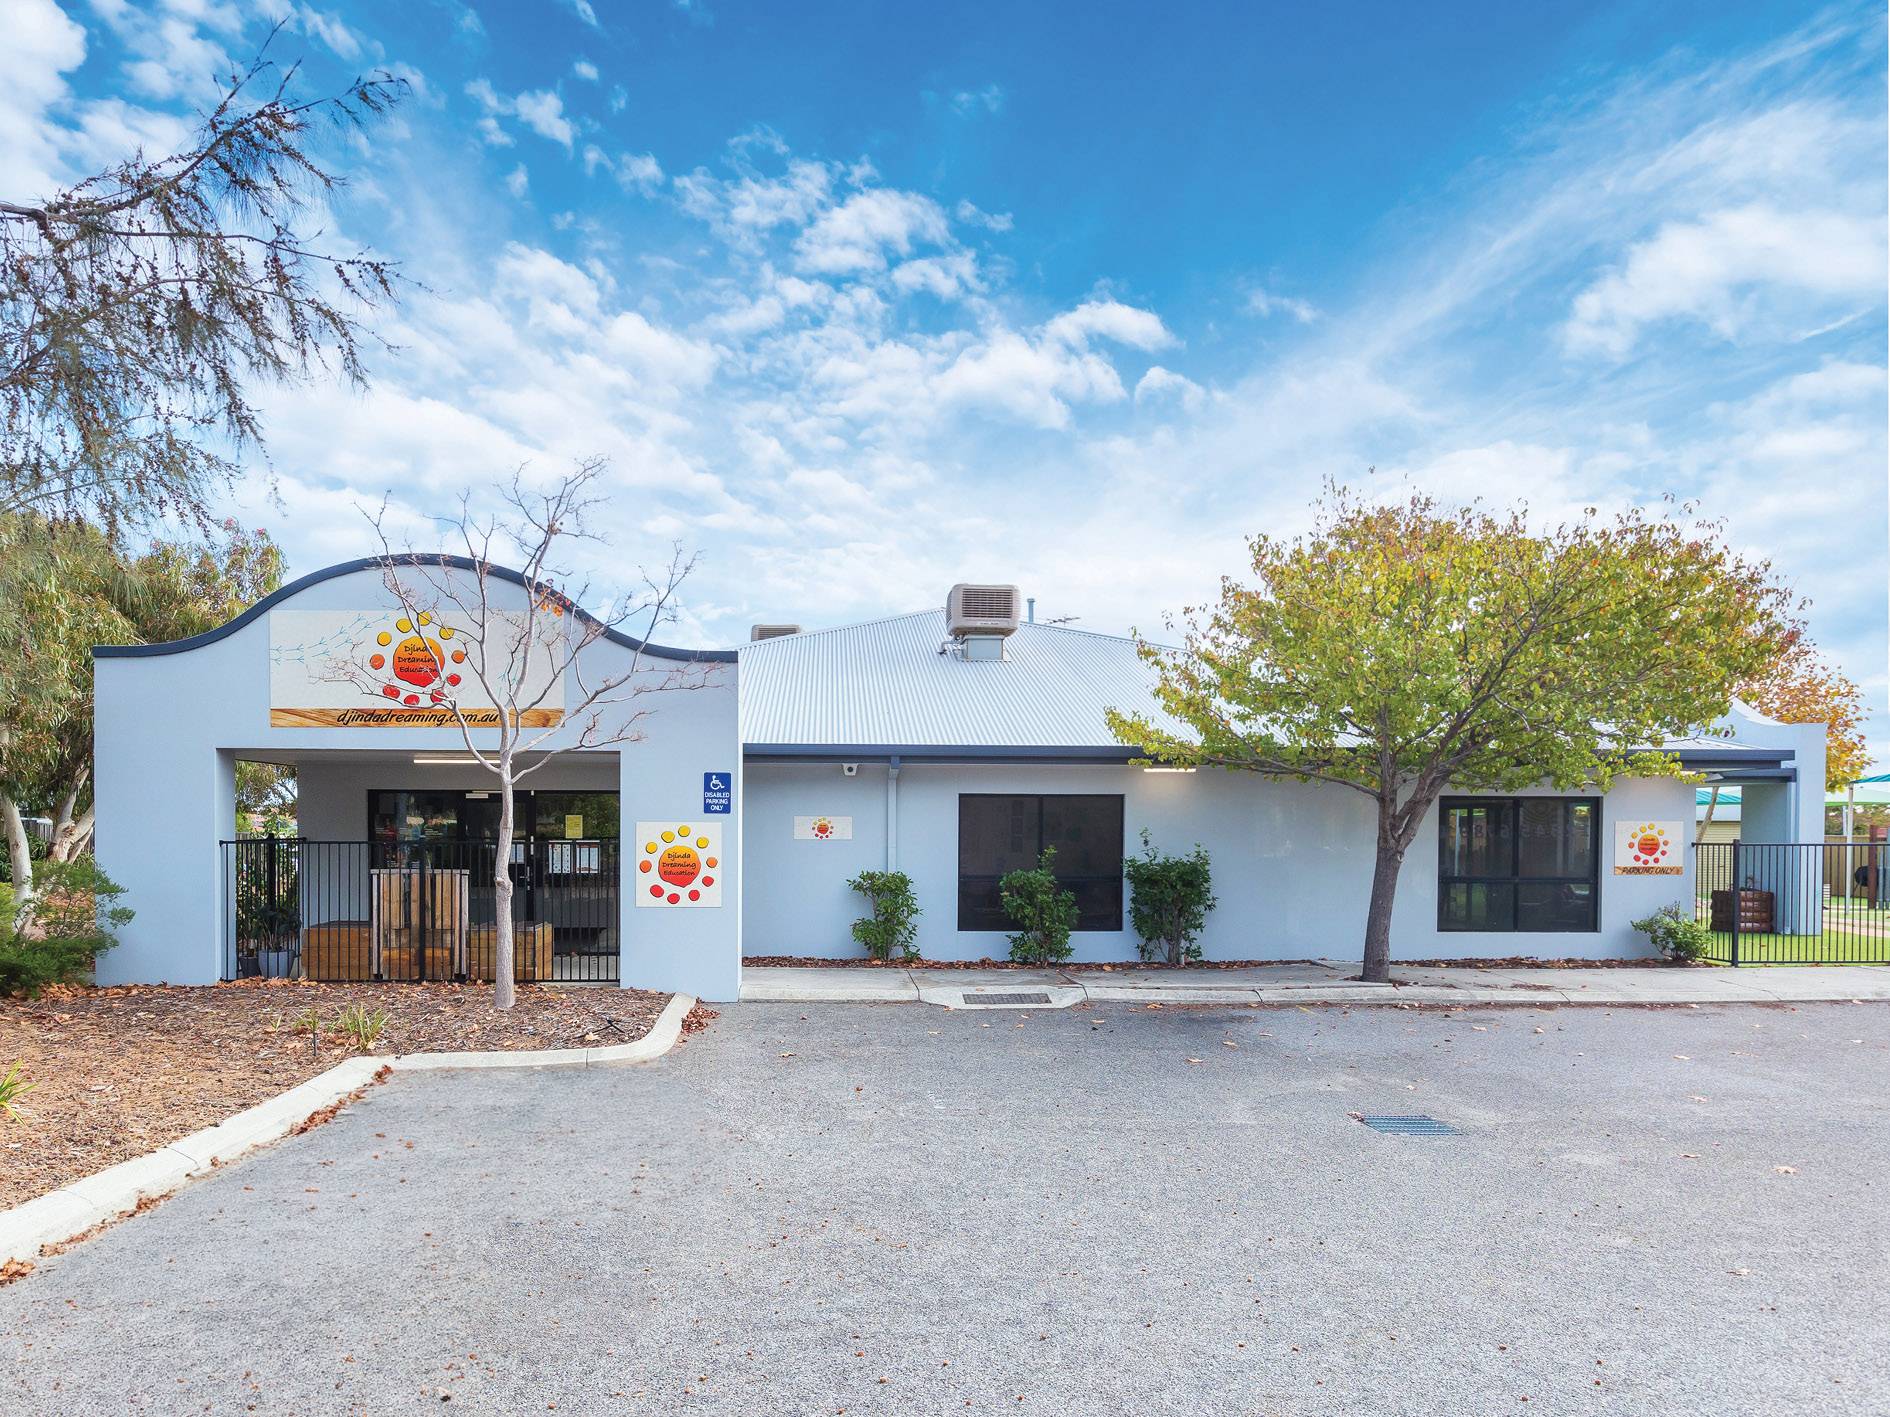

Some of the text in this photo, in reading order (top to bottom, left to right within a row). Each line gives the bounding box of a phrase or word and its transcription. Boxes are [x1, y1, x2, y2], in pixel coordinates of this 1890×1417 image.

[397, 655, 441, 666] Dreamin
[1621, 866, 1674, 875] PARKING ONLY
